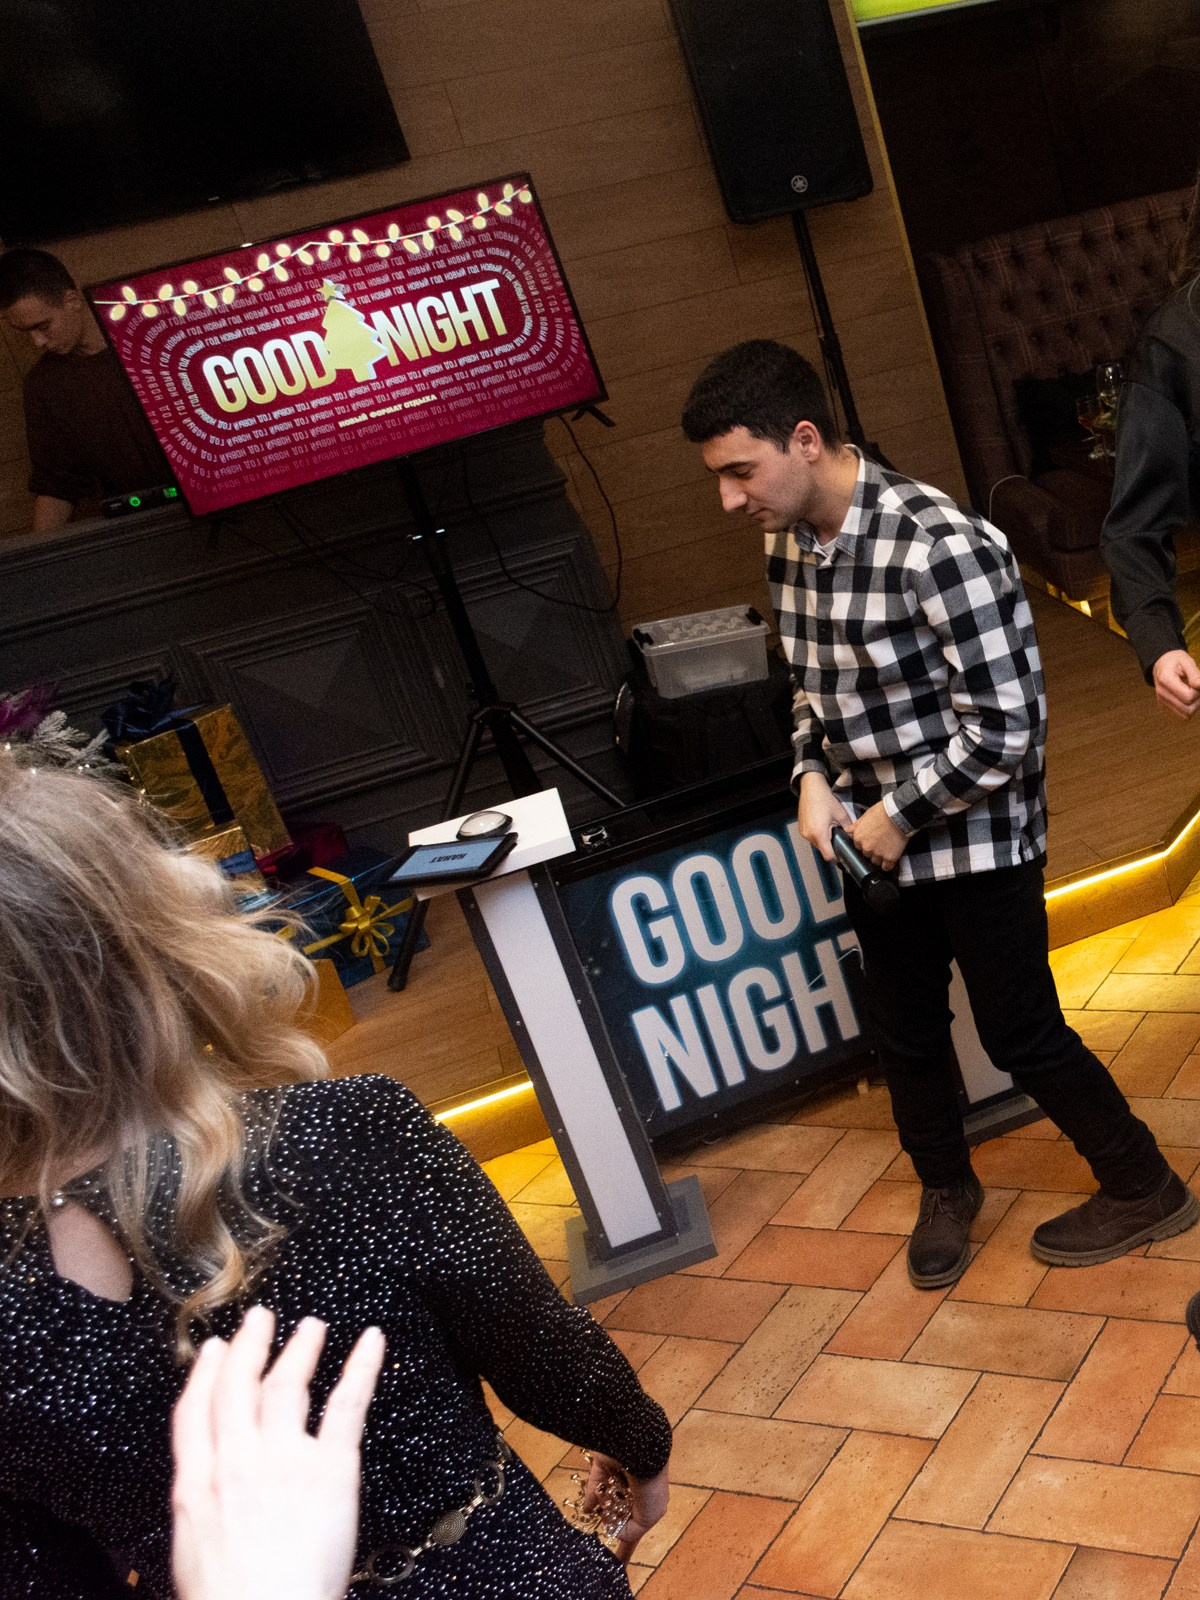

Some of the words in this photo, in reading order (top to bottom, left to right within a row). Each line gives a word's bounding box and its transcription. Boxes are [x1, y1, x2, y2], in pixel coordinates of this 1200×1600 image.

[202, 331, 337, 413] GOOD
[370, 278, 509, 367] NIGHT
[338, 414, 368, 428] НОВЫЙ
[369, 404, 403, 418] ФОРМАТ
[403, 395, 437, 409] ОТДЫХА
[631, 929, 863, 1112] NIGH
